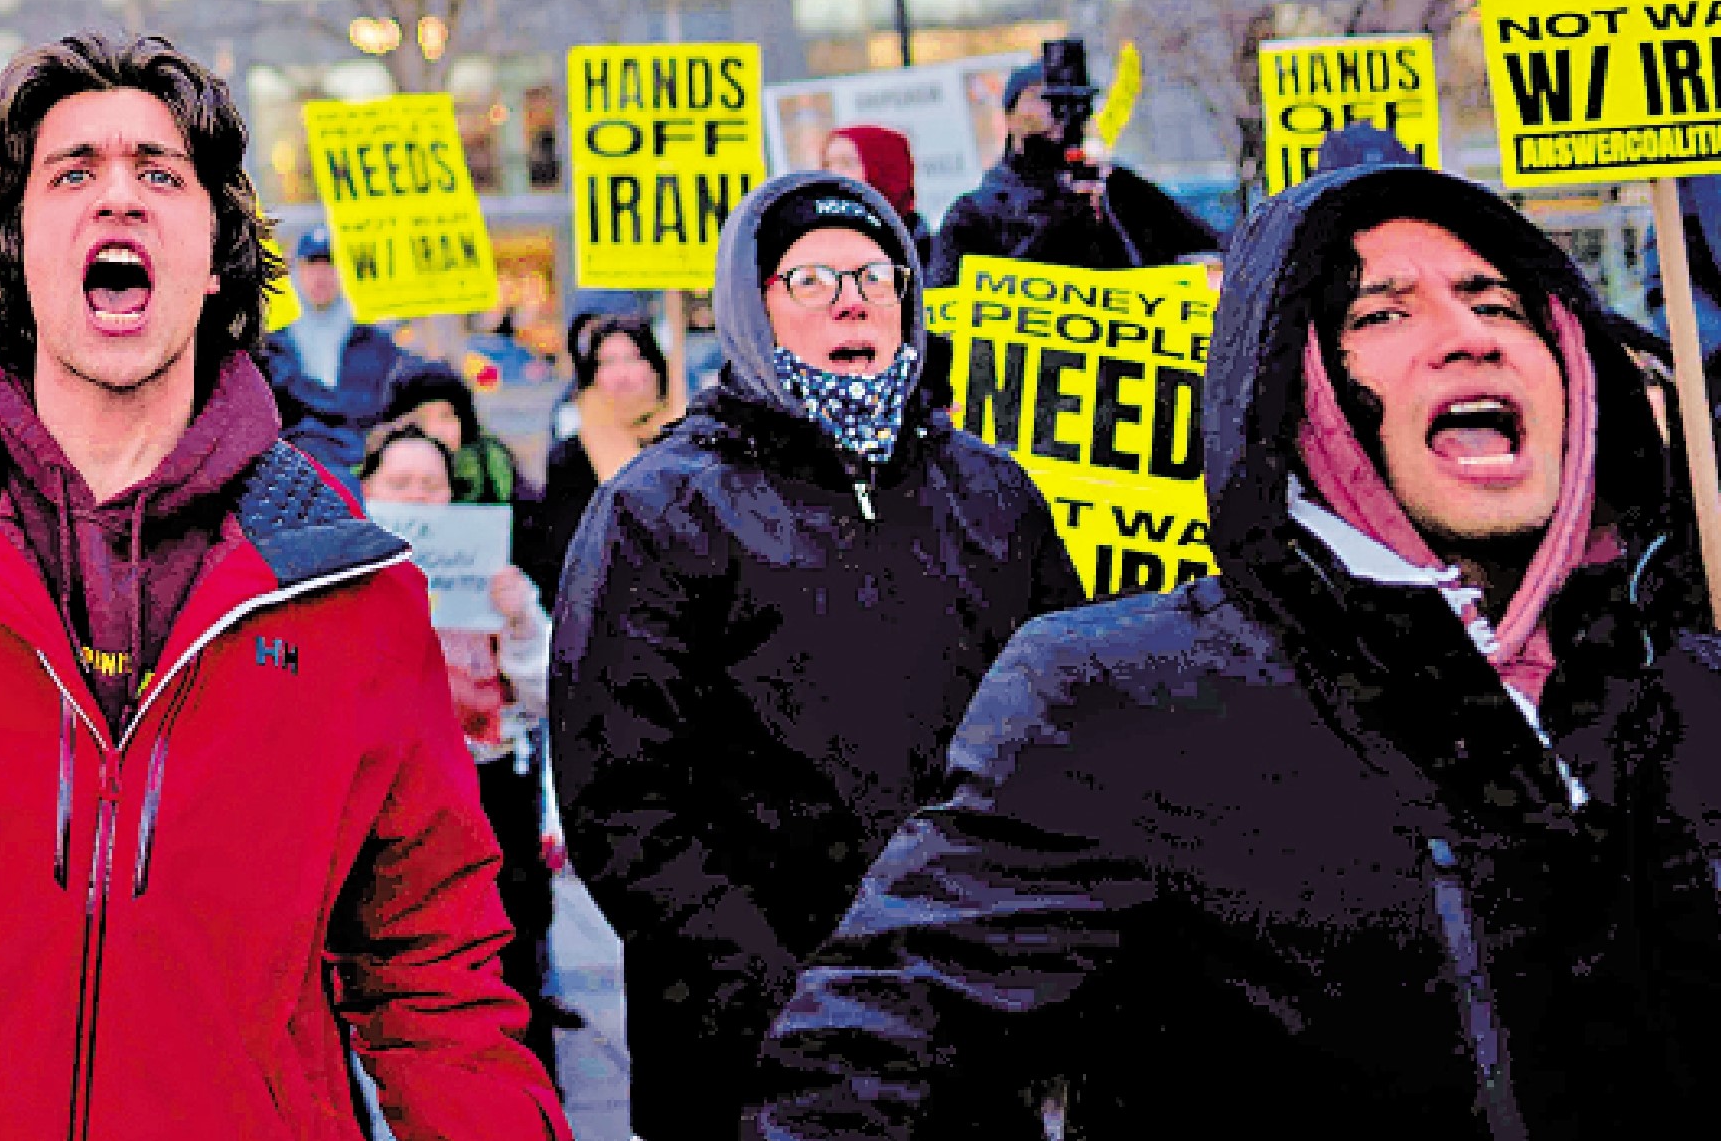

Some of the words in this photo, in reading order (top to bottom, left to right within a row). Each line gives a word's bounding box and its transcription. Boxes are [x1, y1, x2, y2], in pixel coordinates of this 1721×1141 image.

[1498, 7, 1628, 44] NOT
[584, 56, 746, 112] HANDS
[1274, 45, 1421, 96] HANDS
[1504, 43, 1610, 126] W/
[1639, 37, 1721, 116] IR
[585, 118, 749, 157] OFF
[325, 141, 458, 203] NEEDS
[975, 269, 1167, 318] MONEY
[971, 300, 1210, 362] PEOPLE
[965, 336, 1205, 482] NEED
[1110, 504, 1211, 547] WA
